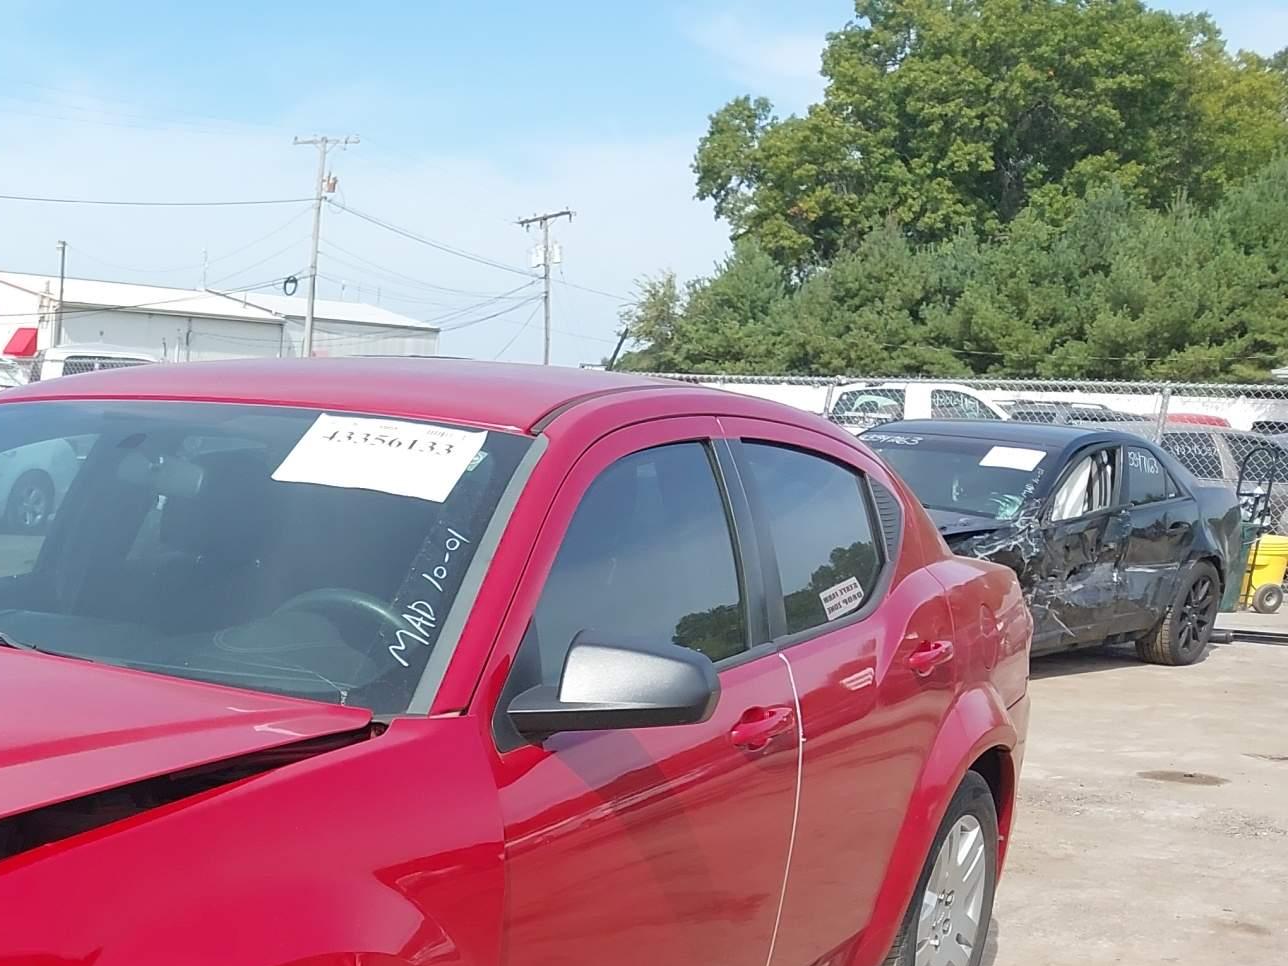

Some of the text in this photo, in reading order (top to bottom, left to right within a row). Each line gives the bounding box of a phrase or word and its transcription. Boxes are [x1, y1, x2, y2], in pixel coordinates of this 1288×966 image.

[321, 430, 455, 456] 43356133
[388, 528, 471, 667] MAD 10-01
